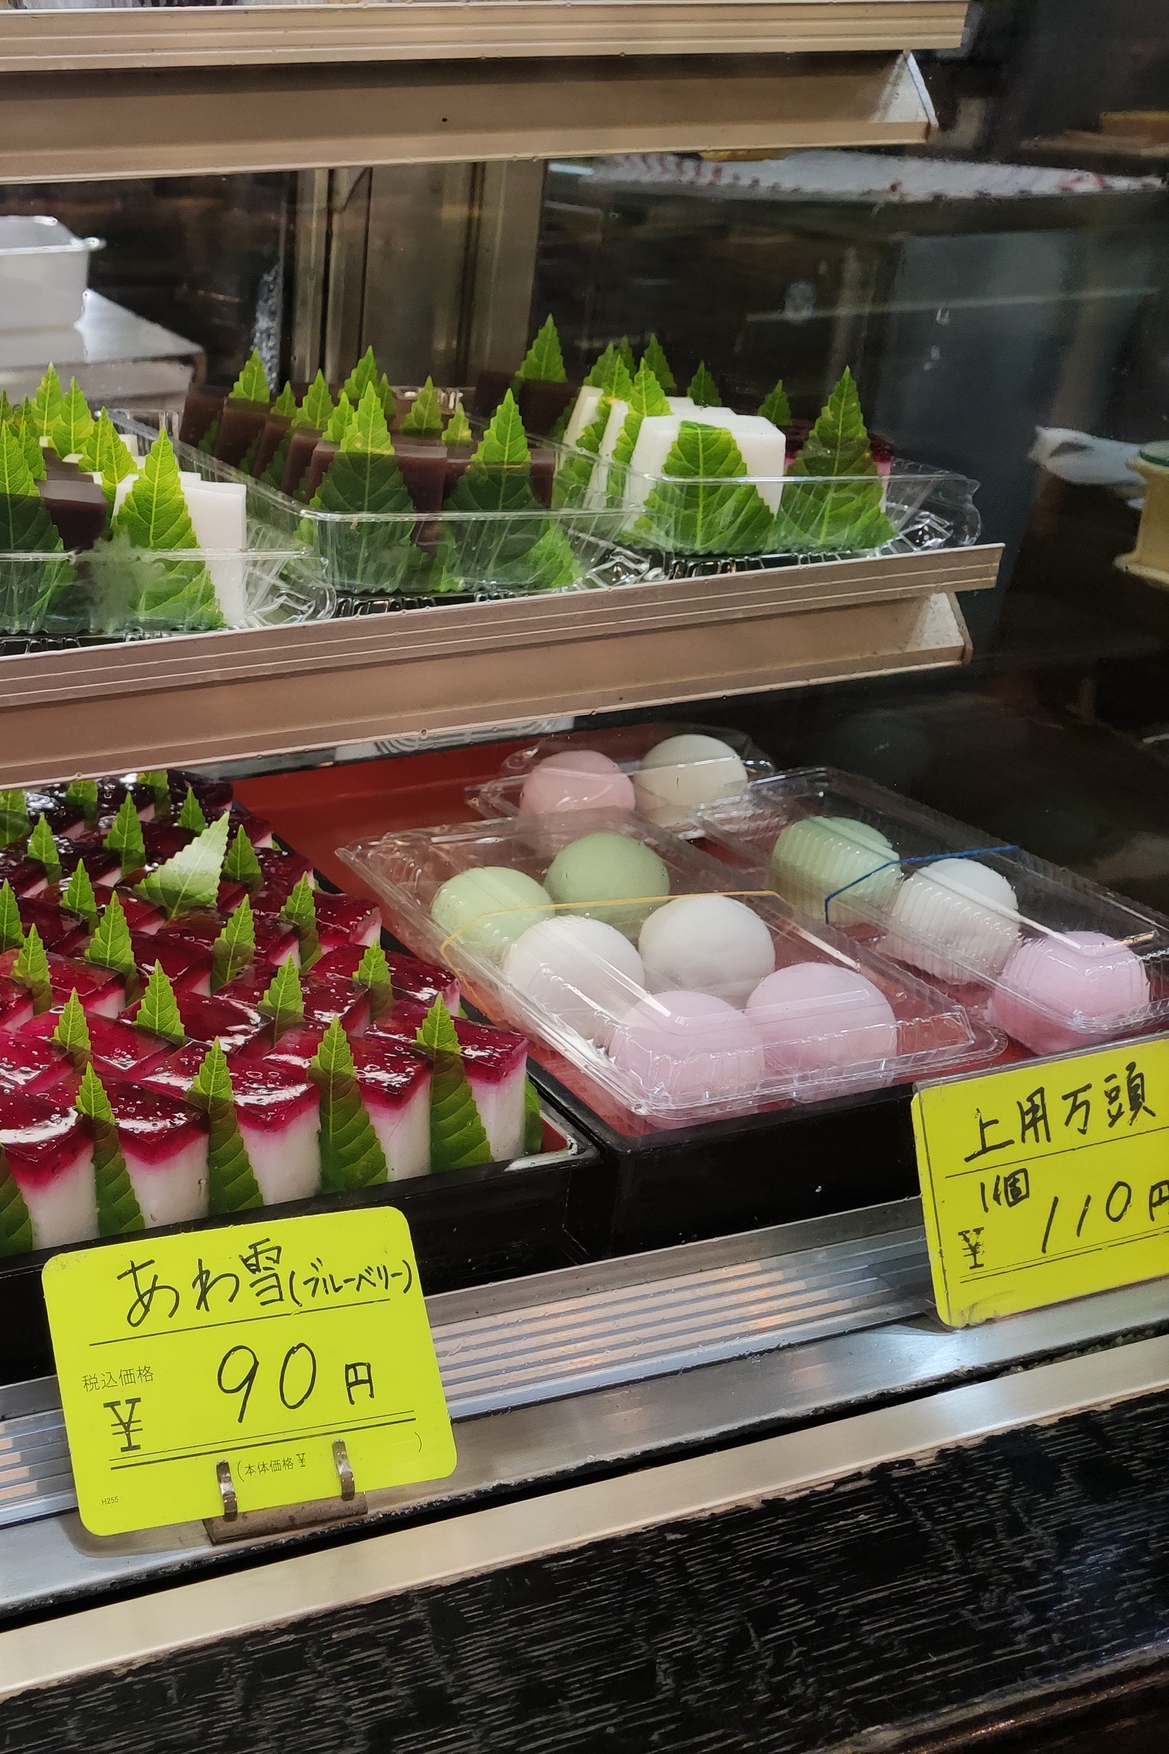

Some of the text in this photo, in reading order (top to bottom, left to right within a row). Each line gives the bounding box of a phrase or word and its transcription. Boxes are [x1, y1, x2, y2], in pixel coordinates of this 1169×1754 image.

[963, 1061, 1157, 1163] 上用万頭
[81, 1365, 155, 1392] 税込価格
